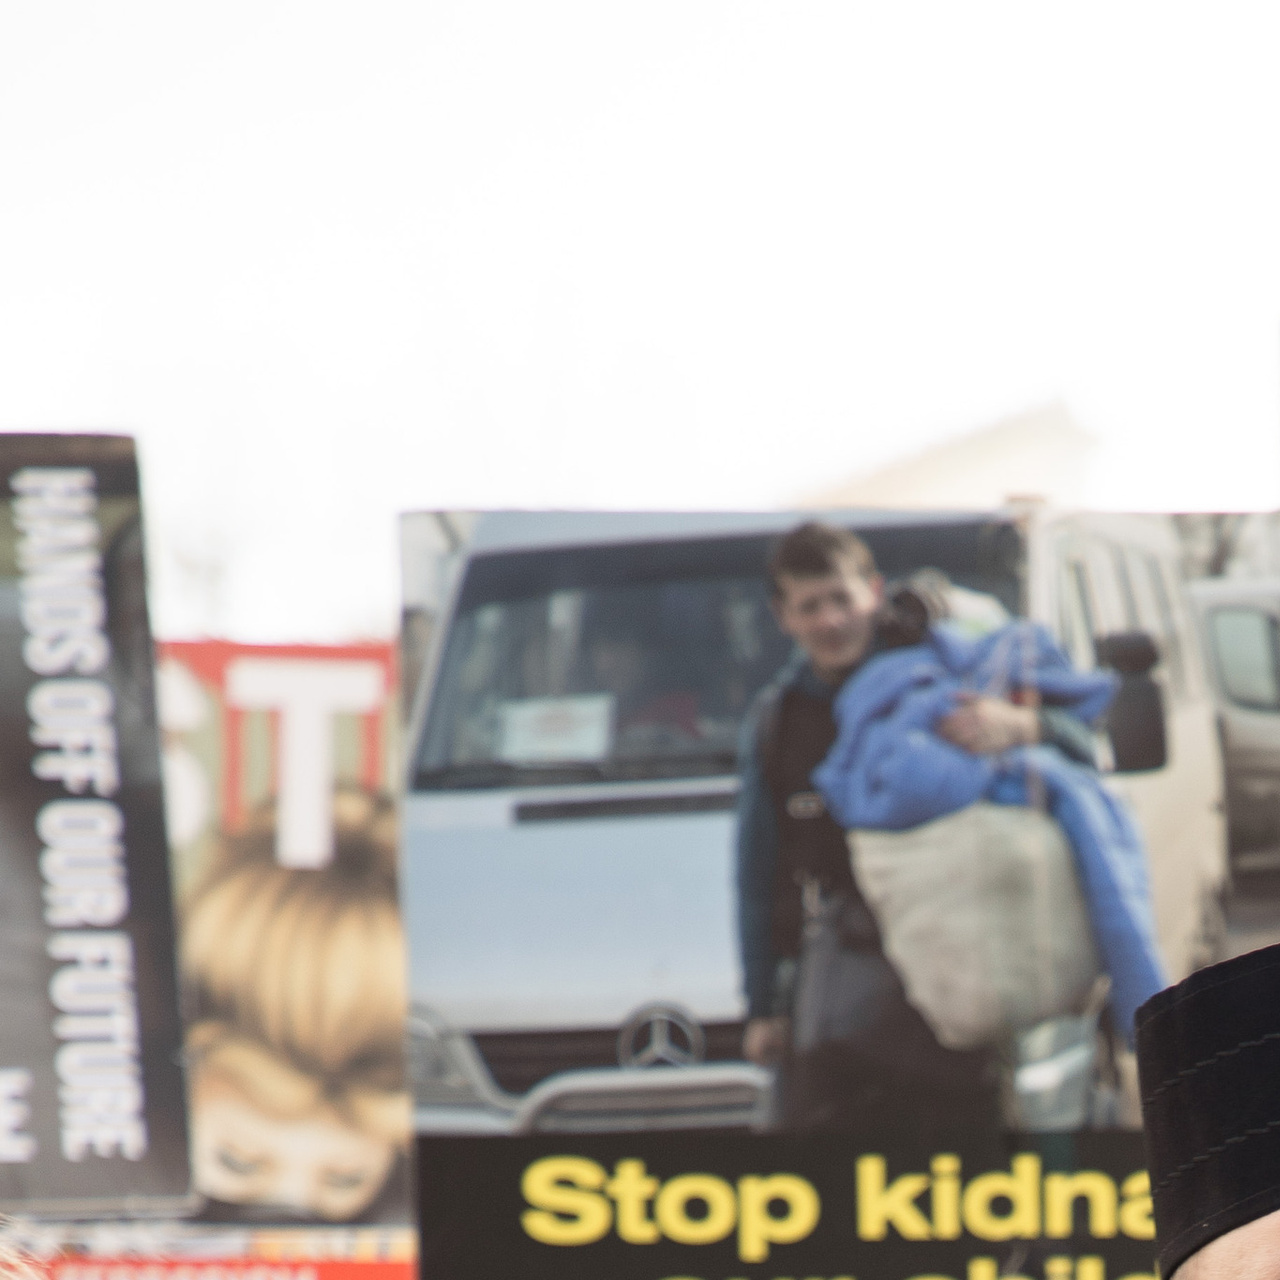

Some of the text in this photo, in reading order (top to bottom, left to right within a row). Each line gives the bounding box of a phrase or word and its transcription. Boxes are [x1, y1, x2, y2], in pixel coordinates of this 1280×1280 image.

[9, 466, 148, 1162] HANDS OFF OUR FUTURE
[520, 1154, 821, 1263] Stop
